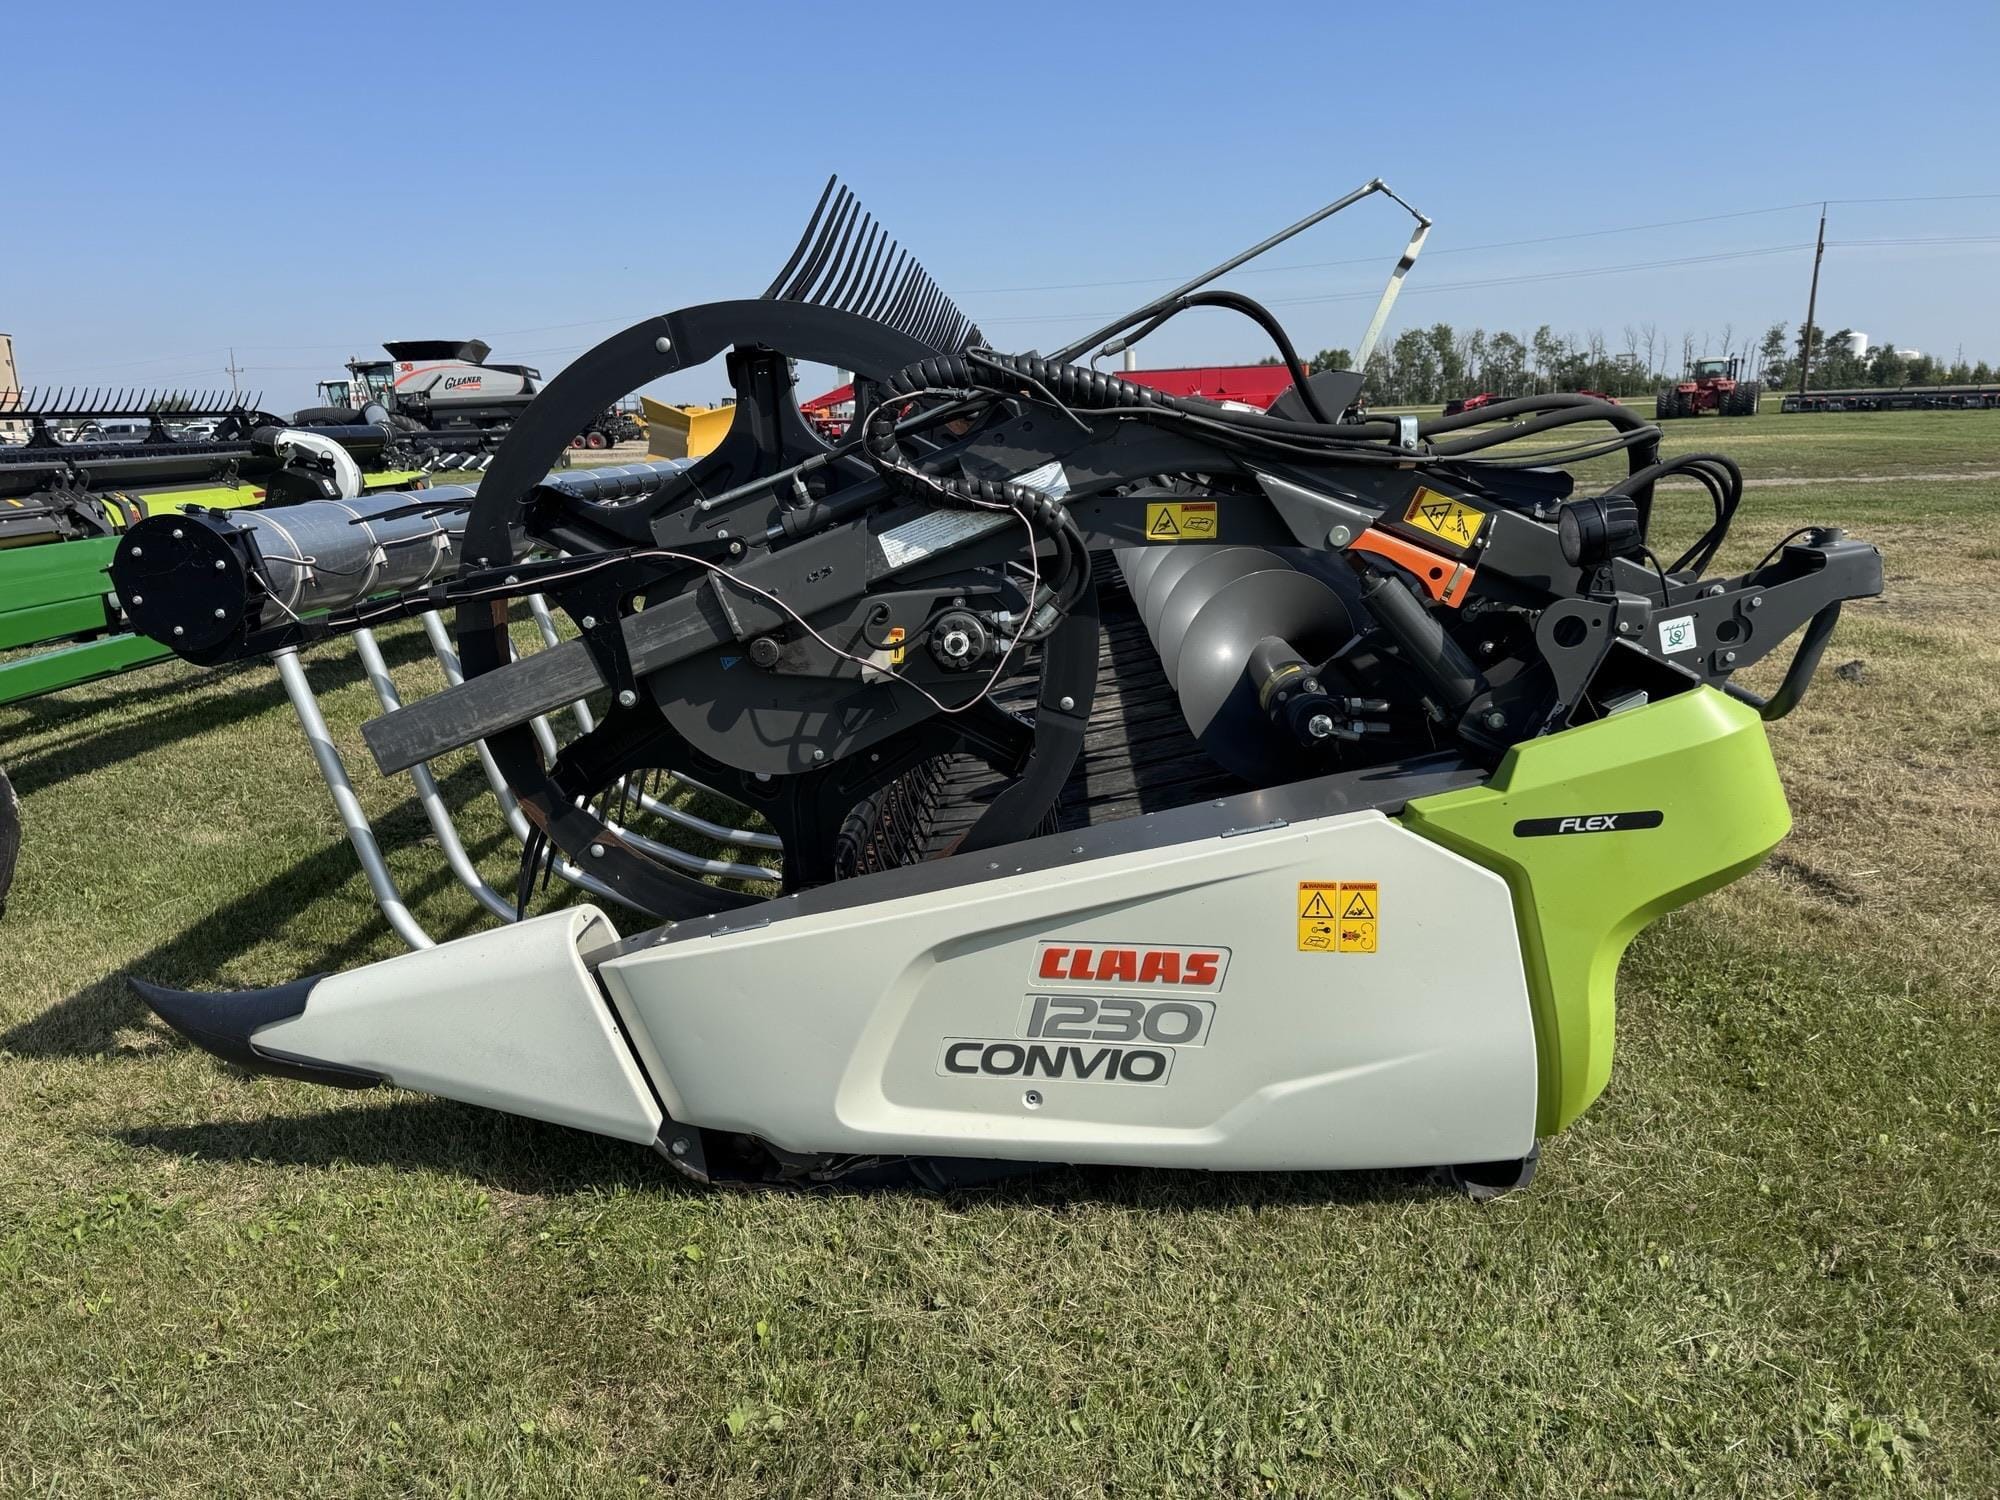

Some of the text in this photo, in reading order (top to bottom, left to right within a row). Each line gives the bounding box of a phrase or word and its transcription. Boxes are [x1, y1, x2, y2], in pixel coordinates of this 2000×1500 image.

[1558, 815, 1618, 833] FLEX
[1039, 947, 1220, 985] CLAAS
[1027, 997, 1204, 1044] 1230
[944, 1042, 1167, 1082] CONVIO
